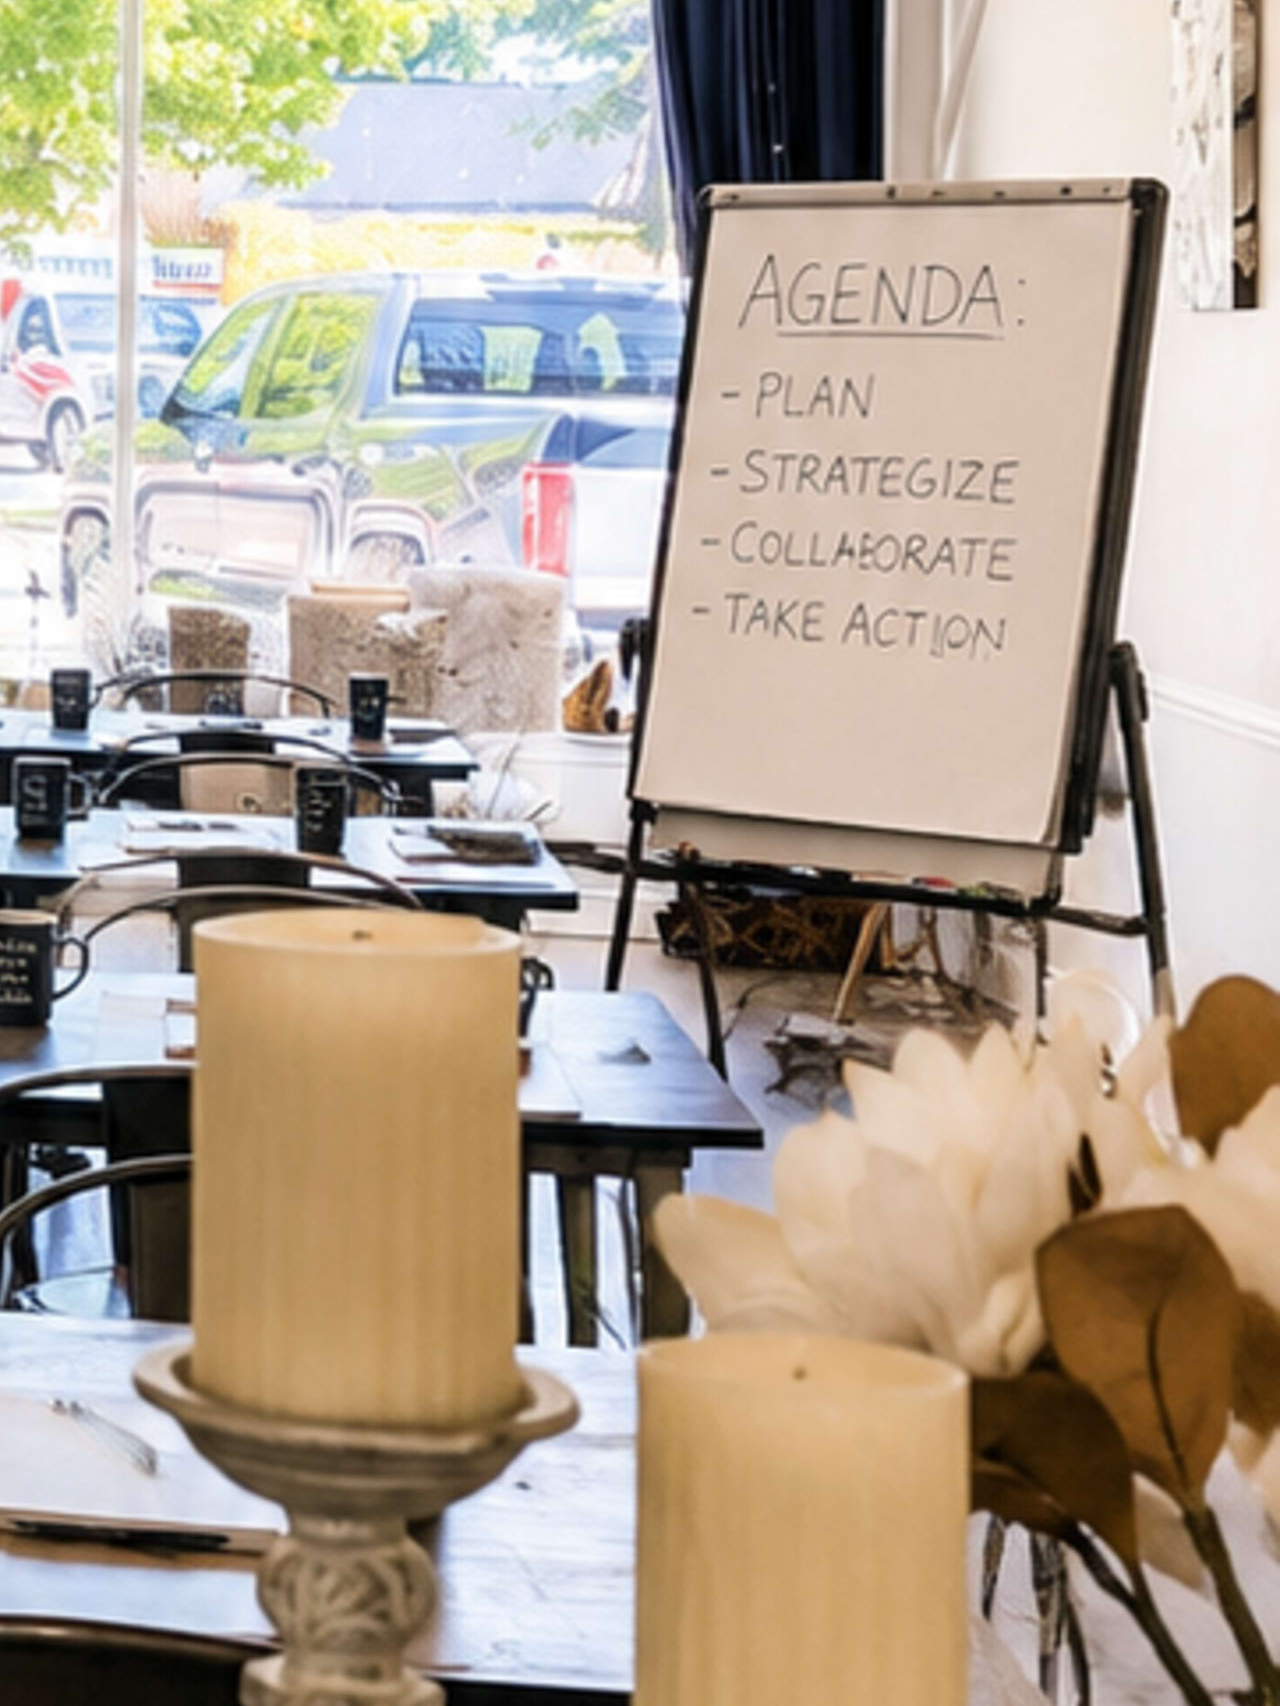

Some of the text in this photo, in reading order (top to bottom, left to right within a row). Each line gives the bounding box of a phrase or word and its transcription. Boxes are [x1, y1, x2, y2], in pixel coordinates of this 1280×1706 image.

[738, 254, 1026, 328] AGENDA:
[755, 371, 875, 419] PLAN
[739, 448, 1020, 505] STRATEGIZE
[731, 520, 1016, 582] COLLABORATE
[724, 592, 825, 643] TAKE
[841, 602, 1007, 659] ACTION
